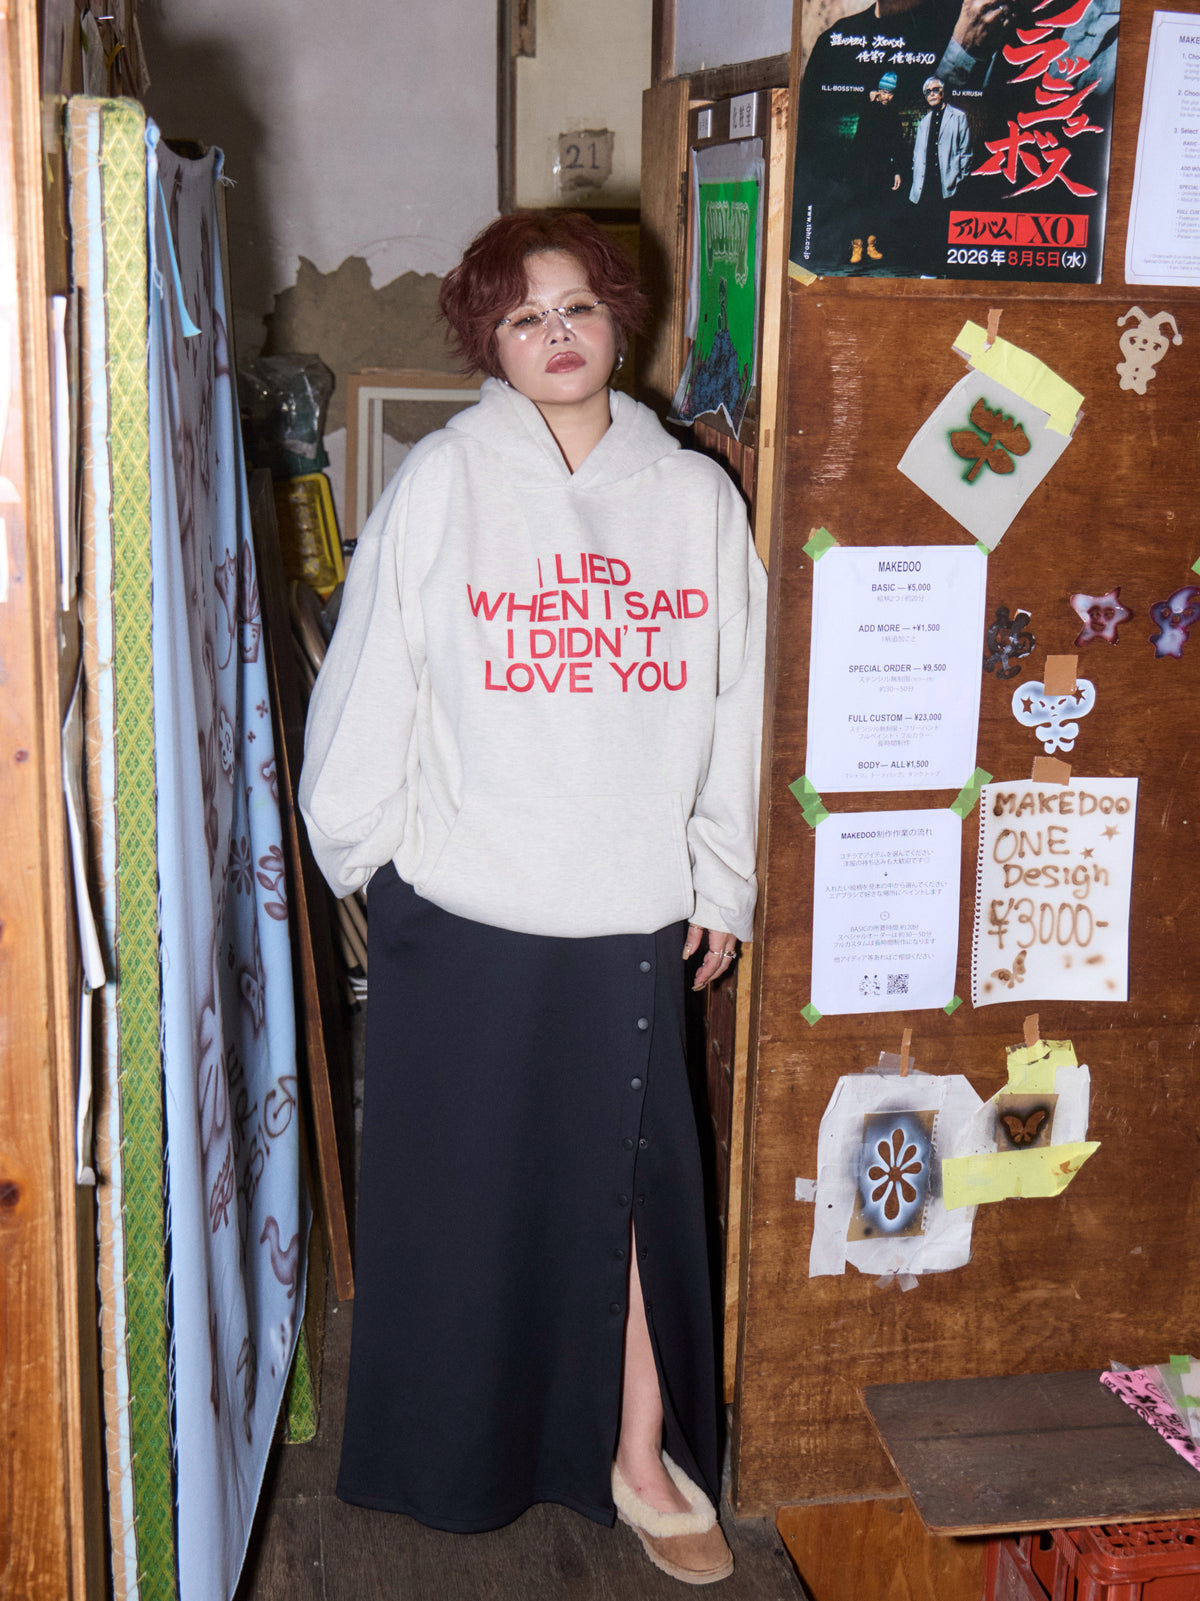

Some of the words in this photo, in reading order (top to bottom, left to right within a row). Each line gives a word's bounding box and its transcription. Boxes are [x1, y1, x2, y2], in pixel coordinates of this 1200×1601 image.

[821, 85, 865, 93] ILL-BOSSTINO
[565, 143, 600, 170] 21
[803, 204, 813, 260] www.tbhr.co.jp
[537, 558, 543, 588] I
[554, 552, 631, 587] LIED
[878, 561, 922, 572] MAKEDOO
[871, 584, 896, 592] BASIC
[907, 583, 931, 592] ¥5,000
[466, 583, 590, 623] WHEN
[604, 590, 611, 620] I
[624, 588, 709, 621] SAID
[507, 629, 514, 659] I
[529, 624, 661, 659] DIDN'T
[858, 624, 875, 633] ADD
[877, 624, 900, 632] MORE
[912, 623, 940, 632] +¥1,500
[484, 660, 593, 693] LOVE
[609, 660, 688, 693] YOU
[848, 664, 882, 673] SPECIAL
[884, 664, 912, 672] ORDER
[923, 663, 947, 672] ¥9,500
[848, 714, 868, 722] FULL
[869, 713, 903, 722] CUSTOM
[914, 713, 942, 722] ¥23,000
[993, 790, 1131, 818] MAKEDOO
[992, 825, 1071, 864] ONE
